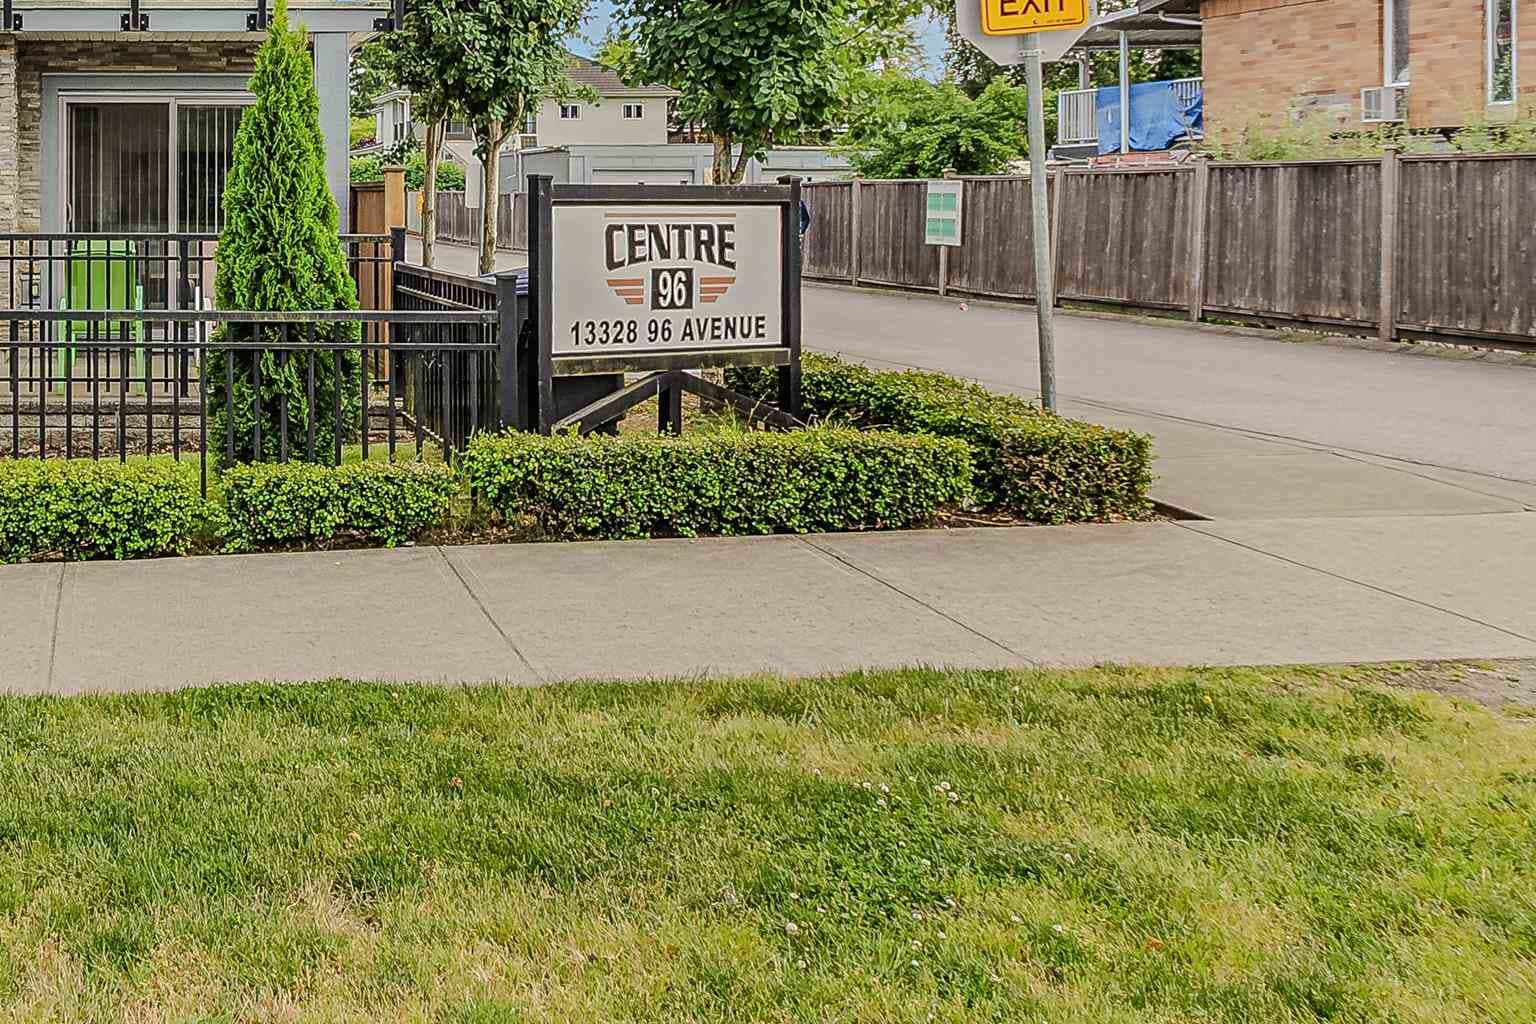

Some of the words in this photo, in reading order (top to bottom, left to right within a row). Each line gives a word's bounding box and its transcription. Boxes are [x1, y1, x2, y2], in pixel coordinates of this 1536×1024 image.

[605, 224, 736, 270] CENTRE
[658, 270, 686, 307] 96
[570, 320, 637, 345] 13328
[647, 319, 672, 342] 96
[681, 316, 765, 341] AVENUE
